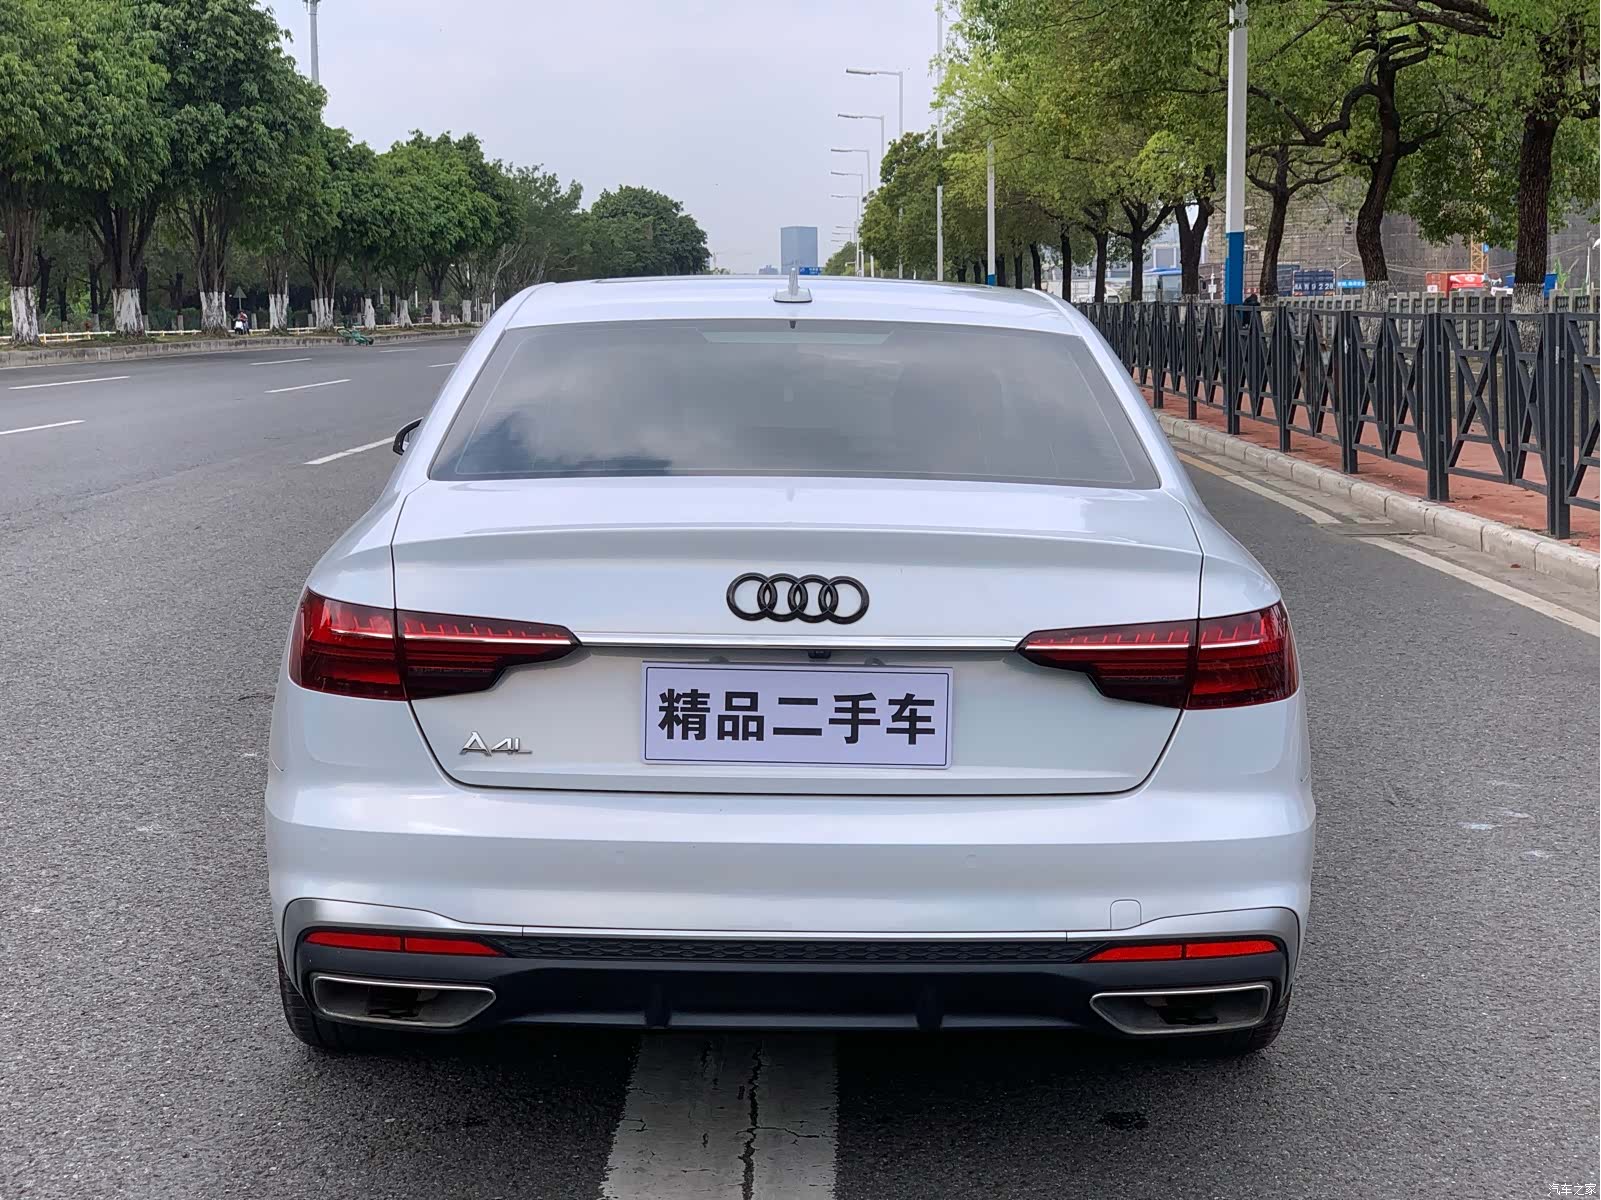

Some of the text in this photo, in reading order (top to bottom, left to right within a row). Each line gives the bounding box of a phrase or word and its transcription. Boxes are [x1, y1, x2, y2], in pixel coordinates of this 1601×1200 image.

[658, 689, 935, 744] 精品二手车
[459, 731, 532, 756] A4L
